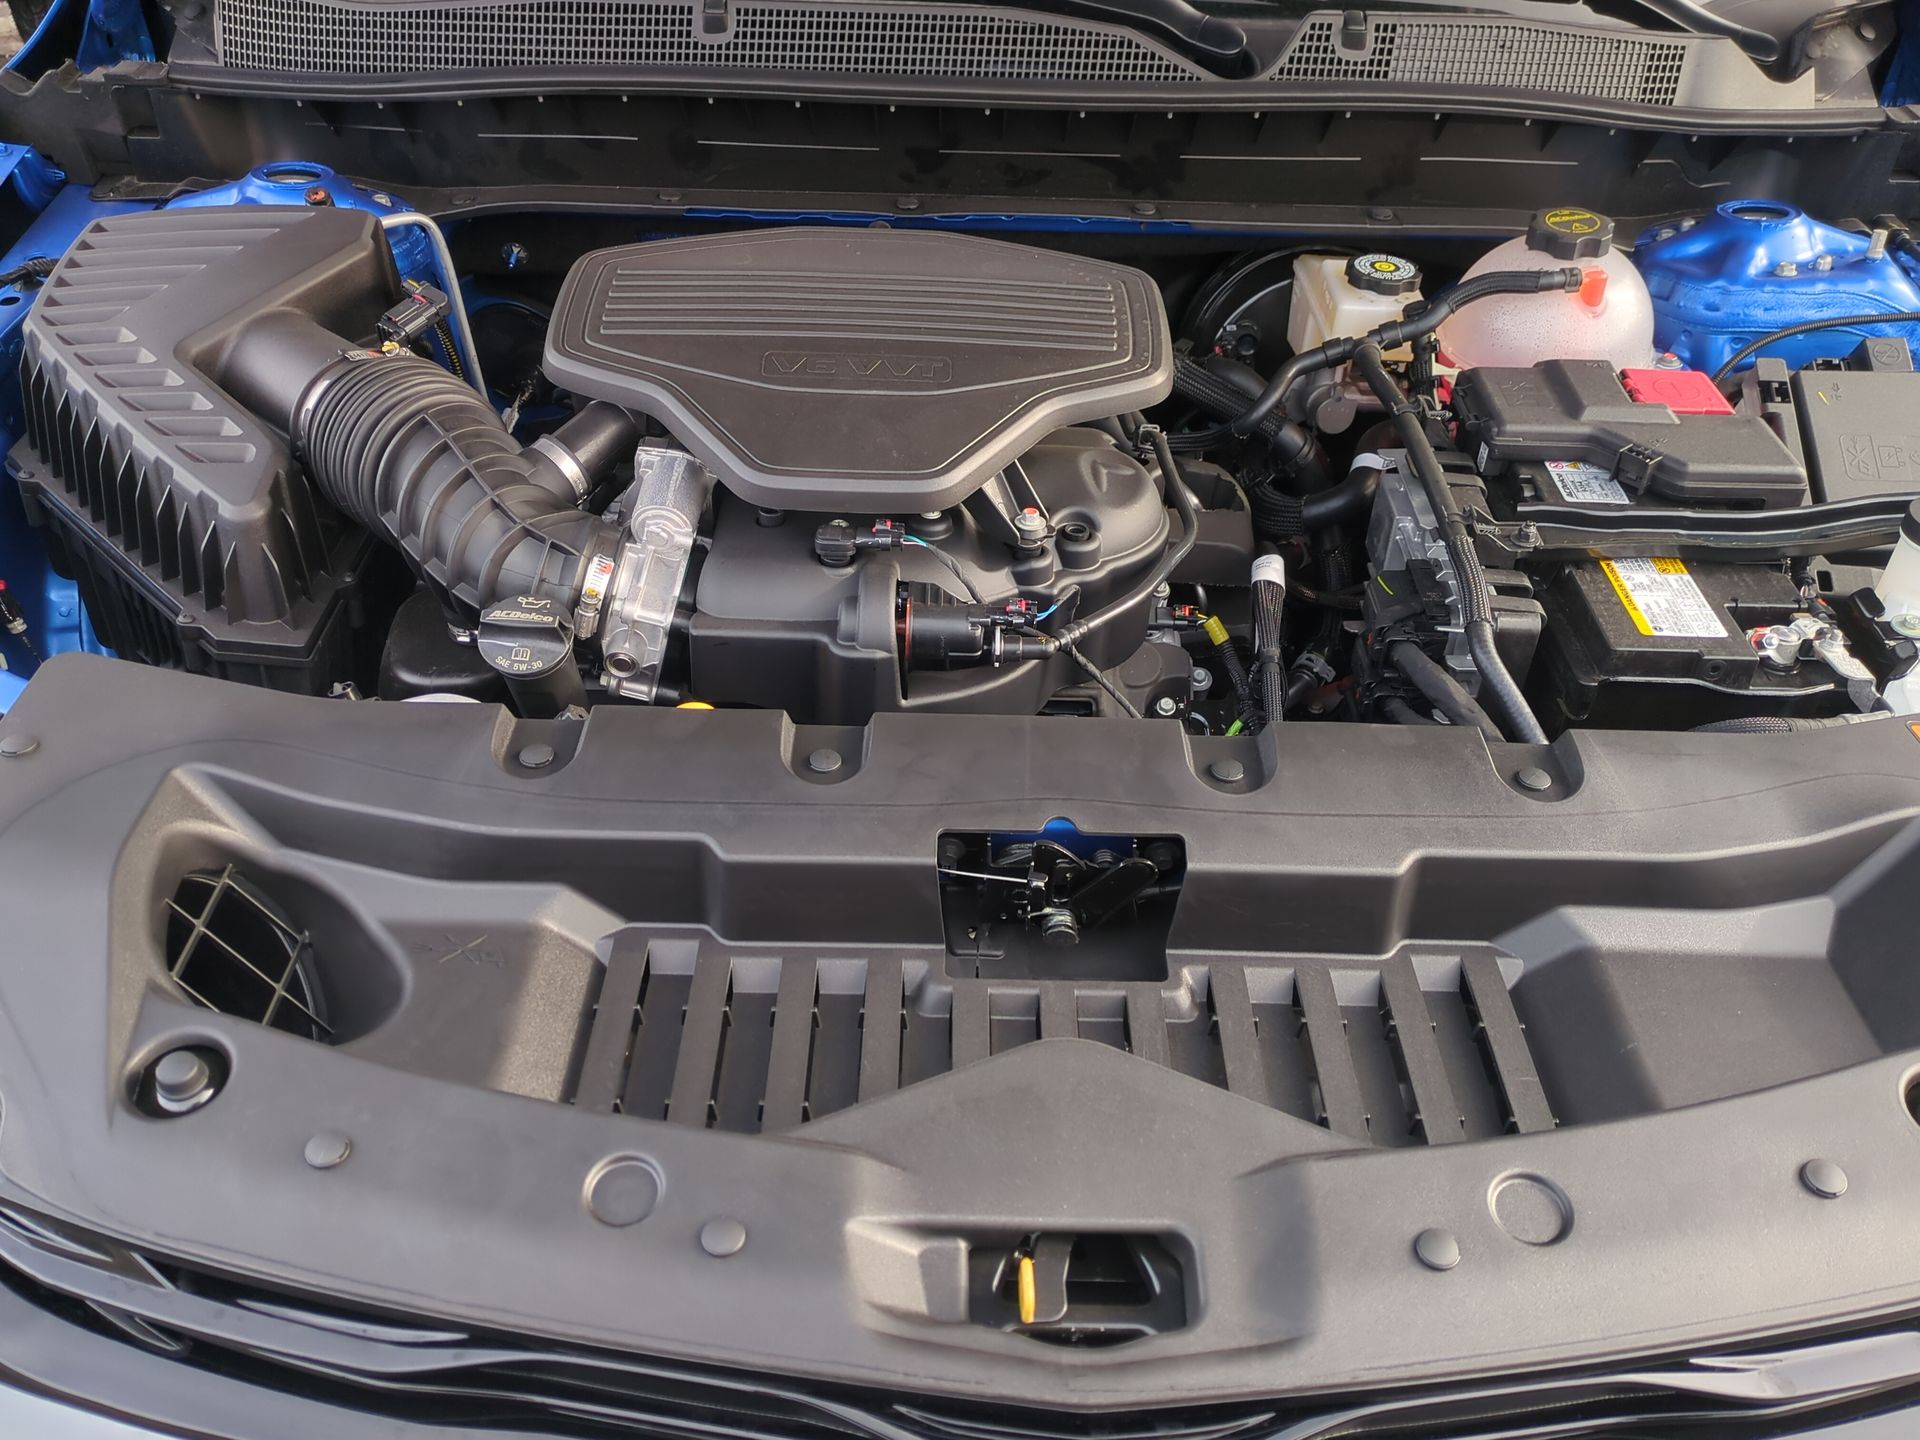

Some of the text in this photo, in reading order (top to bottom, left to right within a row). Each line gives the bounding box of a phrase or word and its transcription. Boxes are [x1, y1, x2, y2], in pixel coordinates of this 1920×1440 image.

[847, 358, 944, 377] VVT
[488, 610, 554, 622] ACDelco
[495, 655, 543, 672] SAE 5W-30
